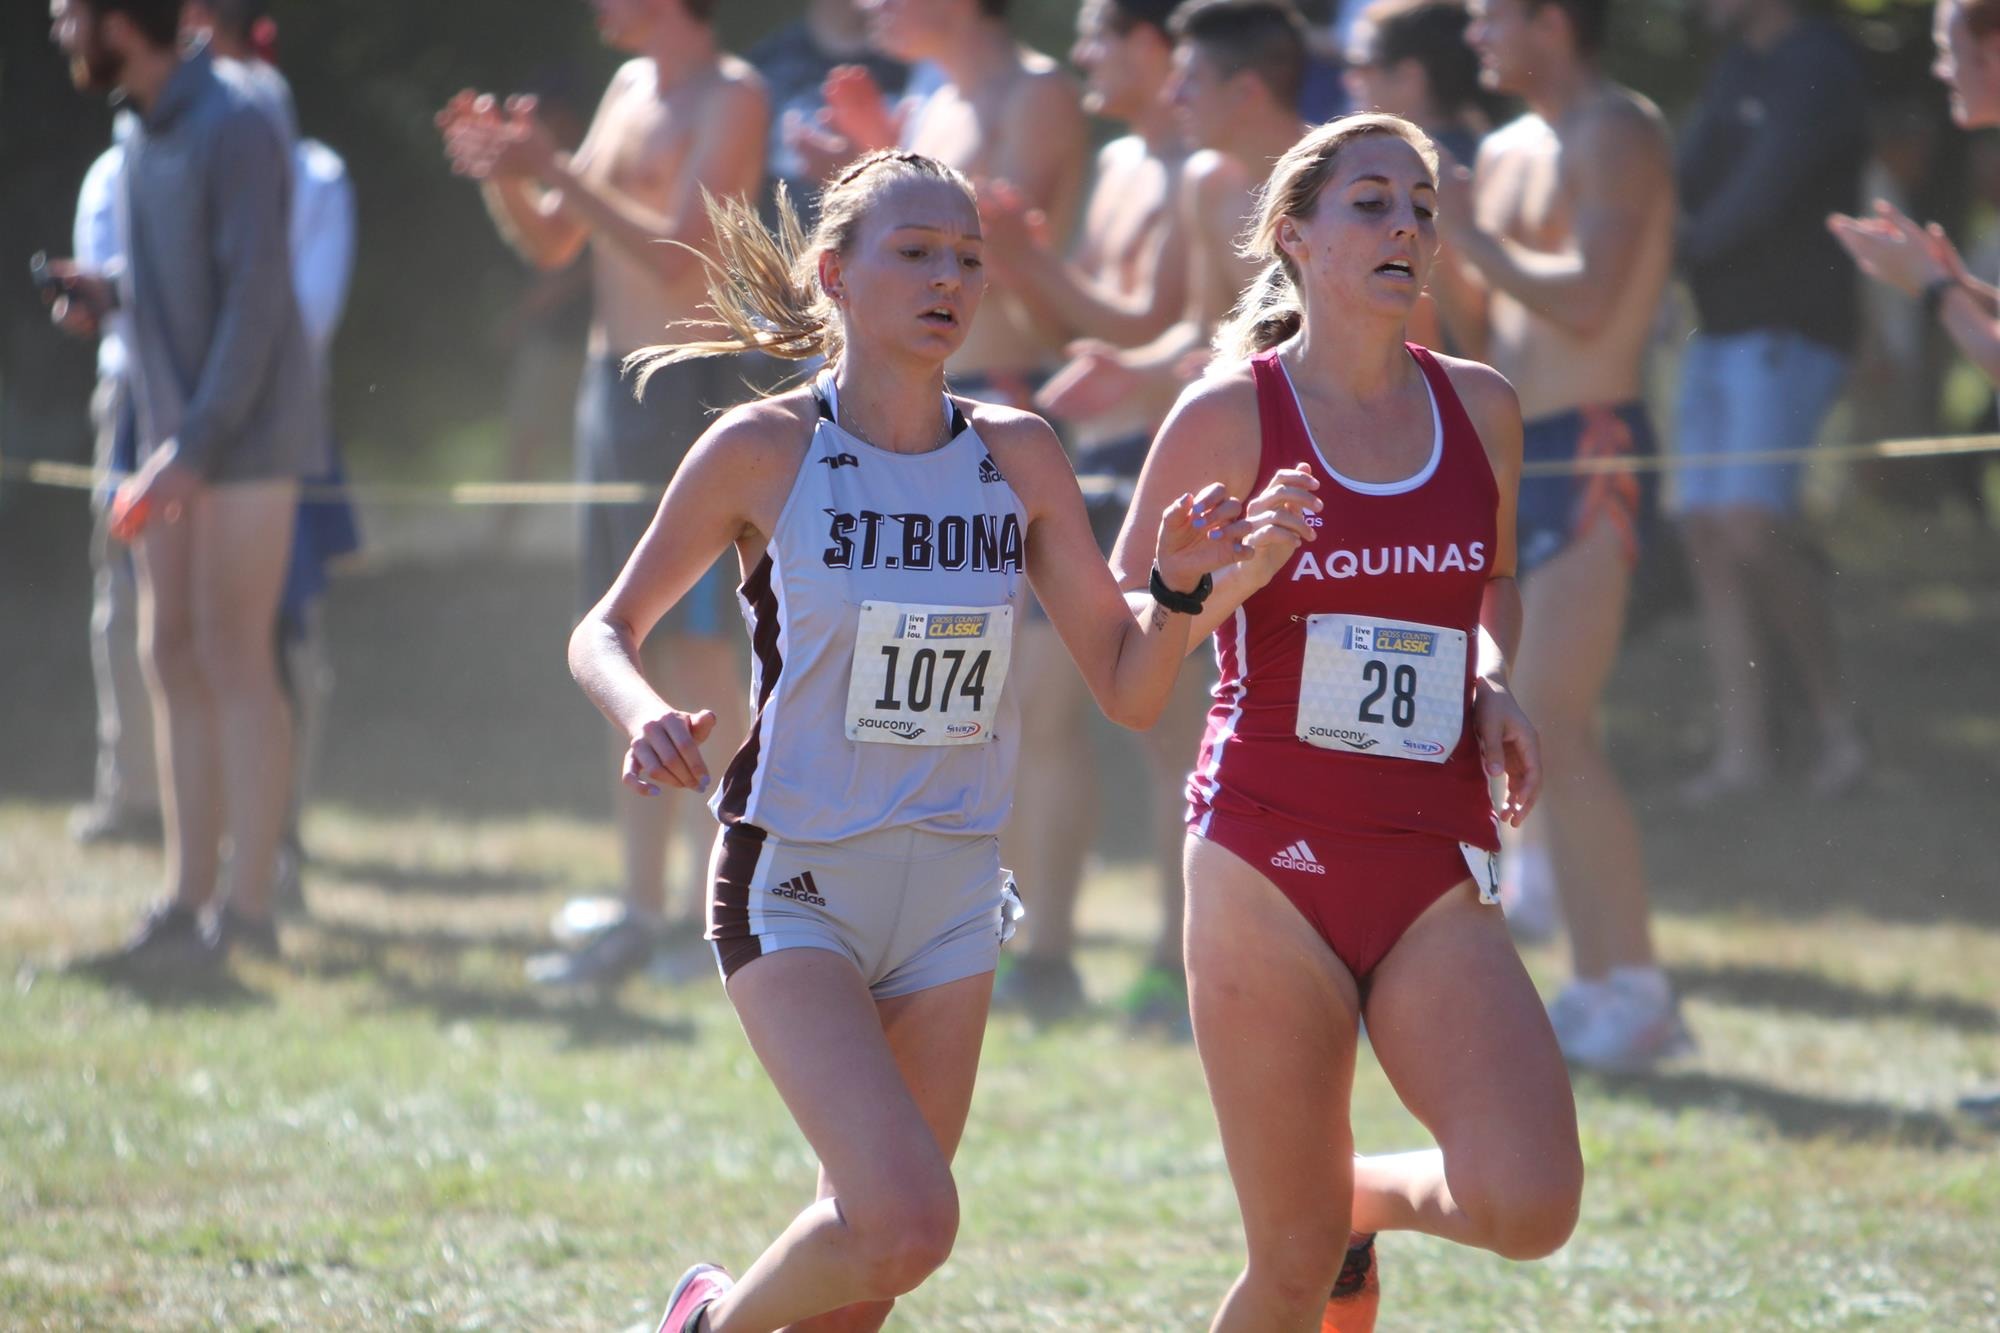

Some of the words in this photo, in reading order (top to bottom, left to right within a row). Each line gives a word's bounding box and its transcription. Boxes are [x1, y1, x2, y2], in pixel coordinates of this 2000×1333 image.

[1291, 541, 1486, 581] AQUINAS
[909, 614, 925, 623] live
[907, 631, 922, 639] lou.
[929, 623, 982, 637] CLASSIC
[1355, 626, 1371, 635] live
[1378, 630, 1401, 639] CROSS
[1401, 632, 1432, 641] COUNTRY
[1355, 642, 1370, 651] lou.
[1376, 637, 1431, 654] CLASSIC
[875, 646, 992, 713] 1074
[1358, 659, 1417, 729] 28
[857, 717, 915, 733] saucony
[1309, 726, 1366, 742] saucony
[1270, 856, 1326, 875] adidas
[771, 887, 826, 907] adidas
